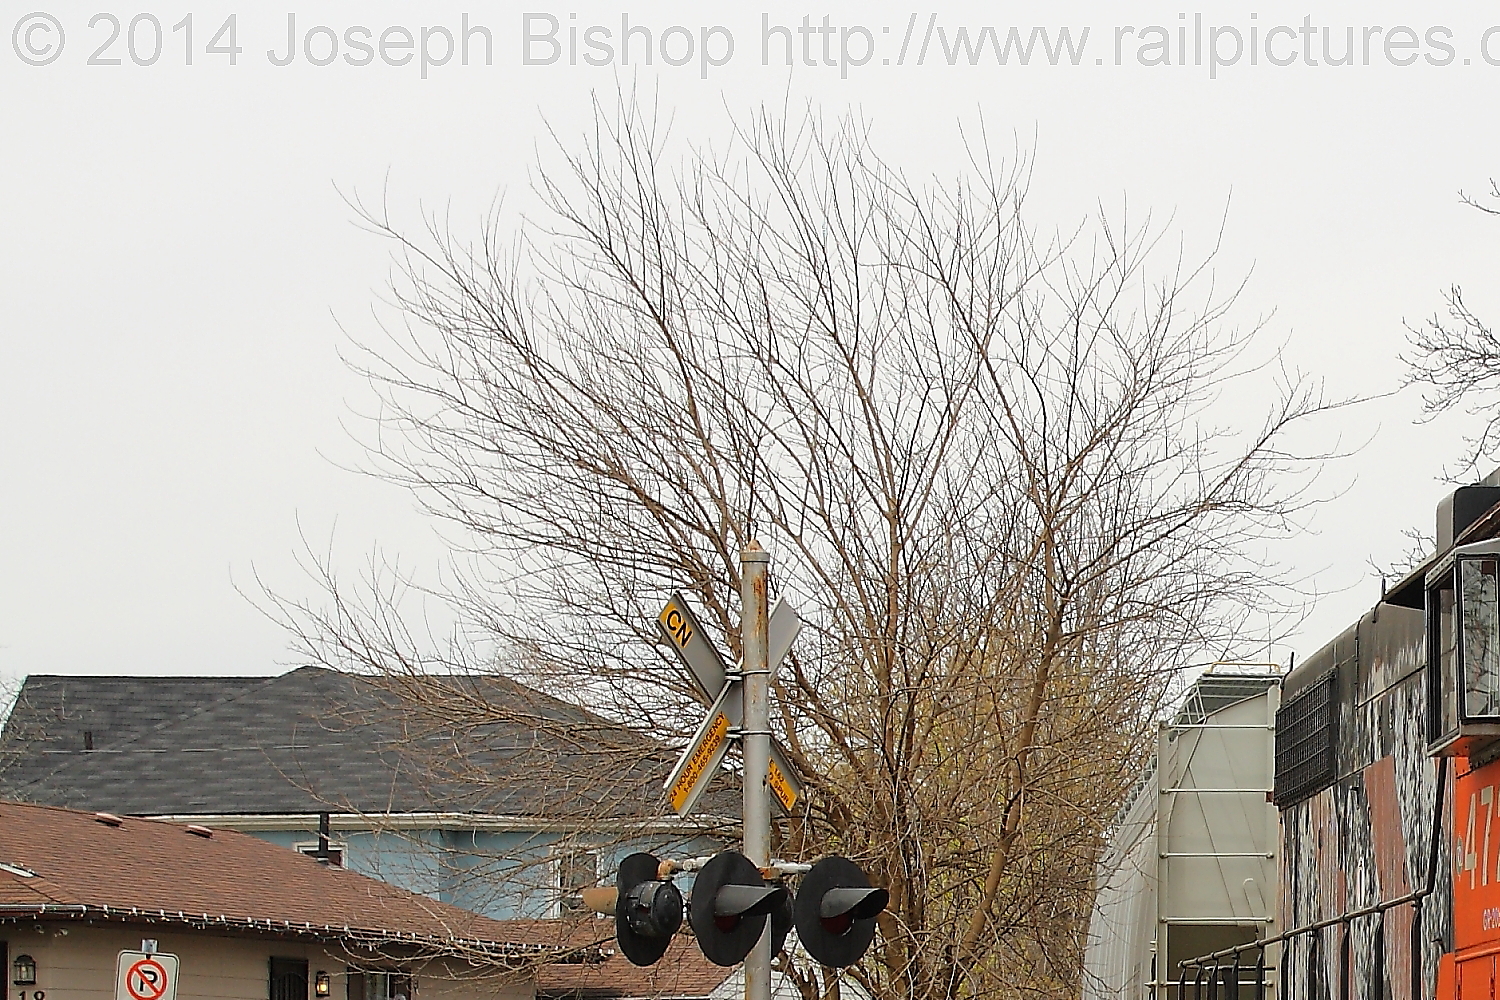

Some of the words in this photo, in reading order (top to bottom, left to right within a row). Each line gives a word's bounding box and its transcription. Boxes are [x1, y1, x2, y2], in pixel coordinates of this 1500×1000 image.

[665, 610, 693, 648] CN
[669, 789, 678, 802] 24
[676, 763, 693, 791] HOUR
[691, 711, 725, 764] EMERGENCY
[773, 780, 789, 804] SPUR
